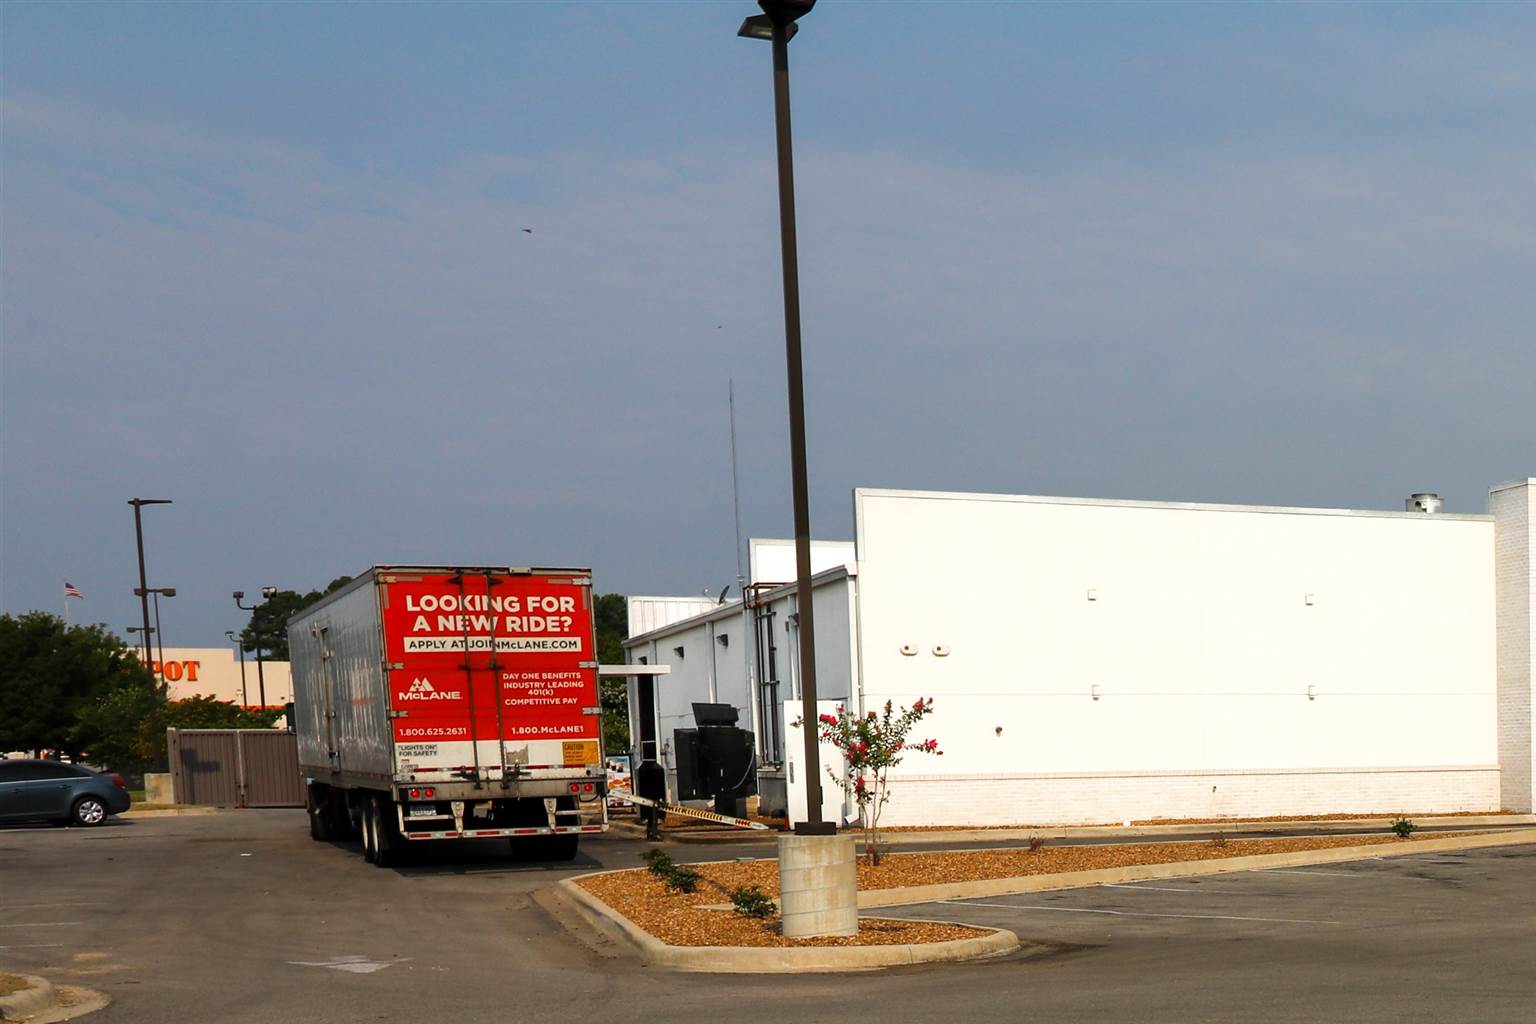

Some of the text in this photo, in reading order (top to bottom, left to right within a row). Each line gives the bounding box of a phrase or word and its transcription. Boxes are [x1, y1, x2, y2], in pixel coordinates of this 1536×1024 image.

[405, 594, 575, 613] LOOKING FOR
[412, 615, 573, 633] A NEW RIDE?
[409, 639, 447, 649] APPLY
[450, 639, 466, 649] AT
[541, 672, 582, 680] BENEFITS
[503, 681, 545, 689] INDUSTRY
[399, 691, 461, 701] McLANE
[527, 688, 554, 696] 401(k)
[504, 697, 578, 706] COMPETITIVE PAY
[399, 727, 467, 736] 1.800.625.2631
[511, 725, 584, 735] 1.800.McLANE1
